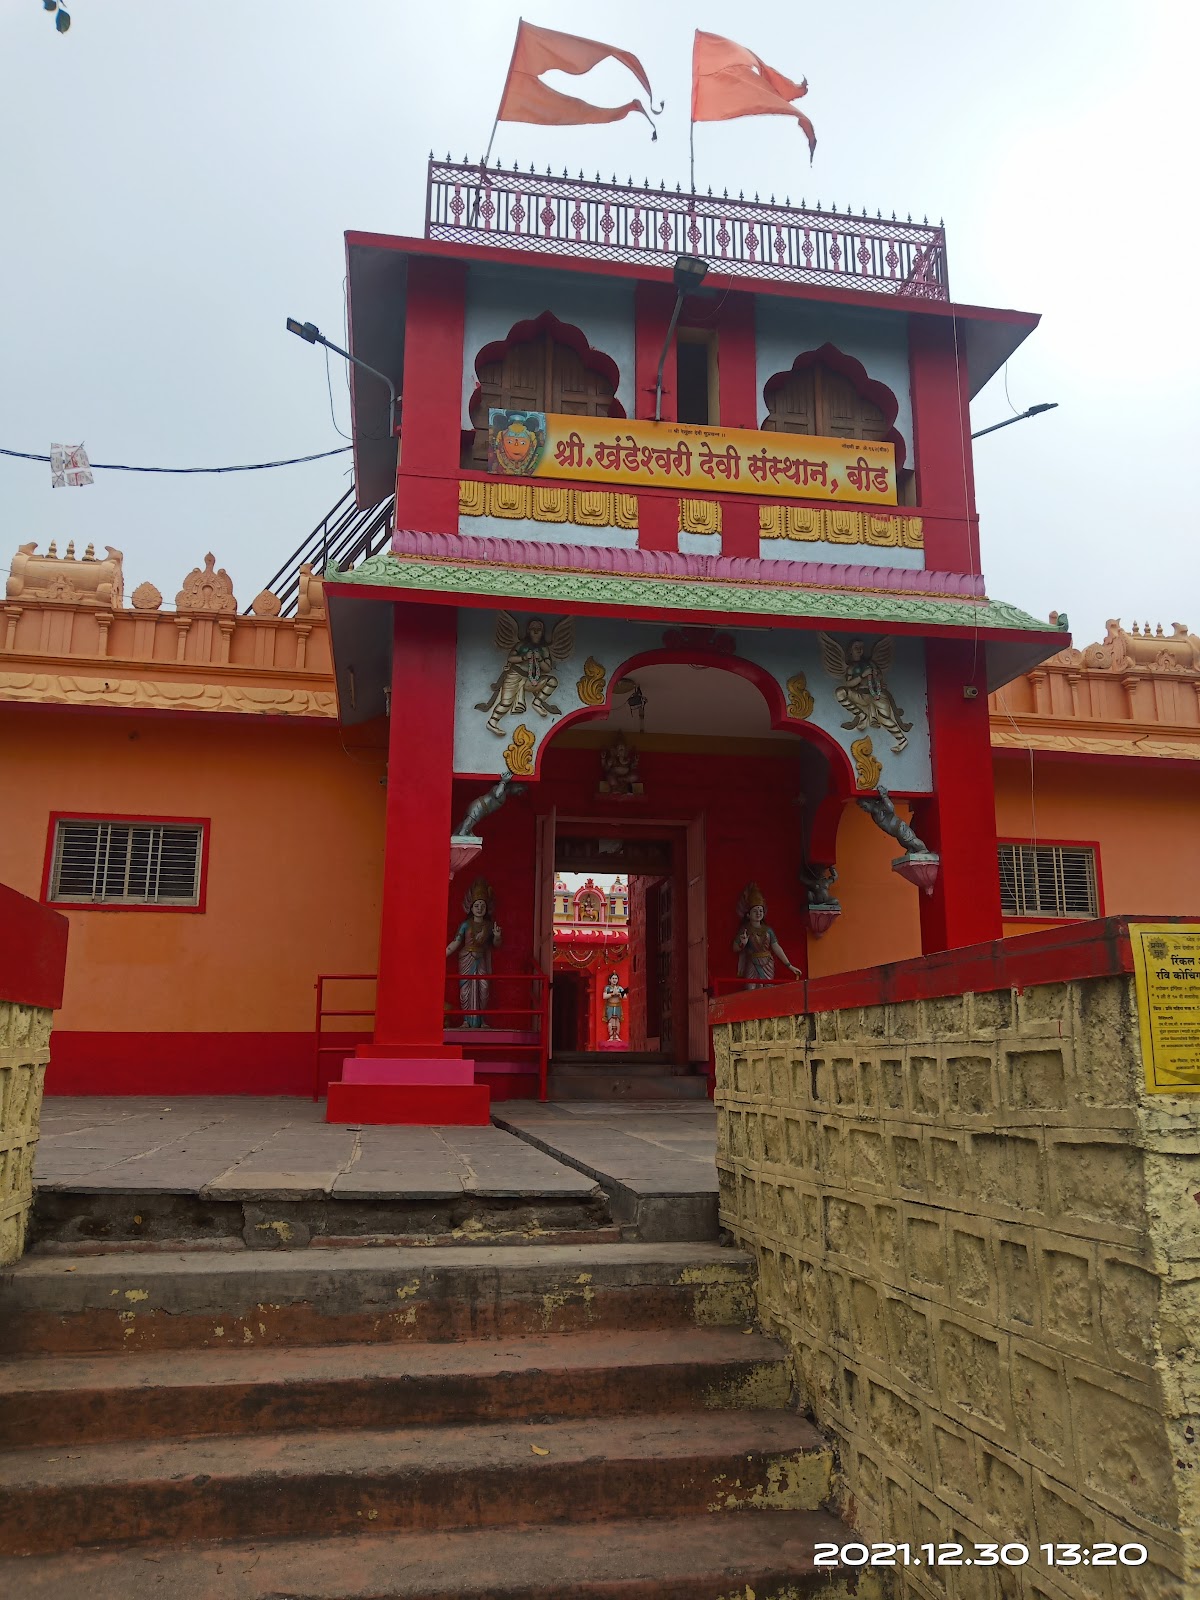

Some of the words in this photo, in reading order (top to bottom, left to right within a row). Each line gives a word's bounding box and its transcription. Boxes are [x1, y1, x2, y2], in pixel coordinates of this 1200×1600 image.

[699, 441, 741, 480] देवी
[747, 447, 839, 495] संस्थान,
[846, 456, 889, 493] बीड
[1171, 954, 1195, 966] रिंकल
[1156, 968, 1170, 980] रवि
